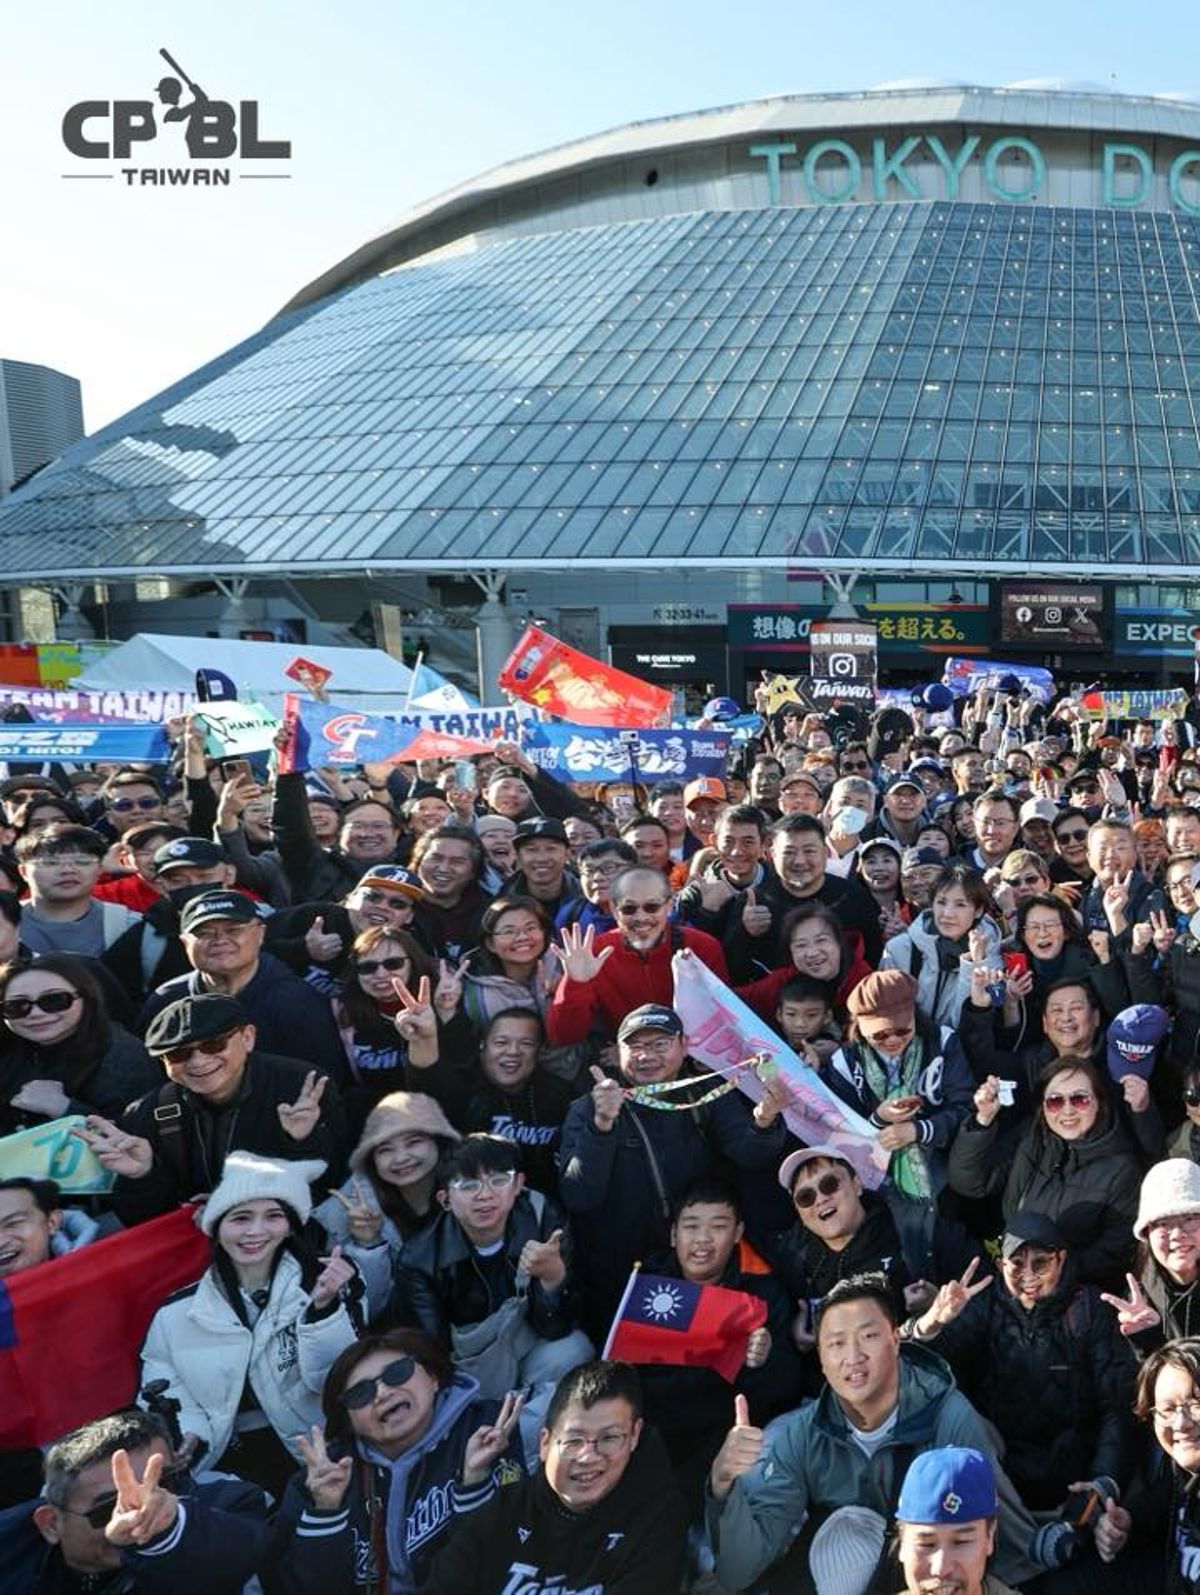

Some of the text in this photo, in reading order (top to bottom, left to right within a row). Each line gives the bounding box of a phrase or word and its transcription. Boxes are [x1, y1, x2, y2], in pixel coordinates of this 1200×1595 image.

[750, 135, 1046, 206] TOKYO
[1127, 624, 1197, 642] EXPEC
[429, 709, 521, 743] TAIWA
